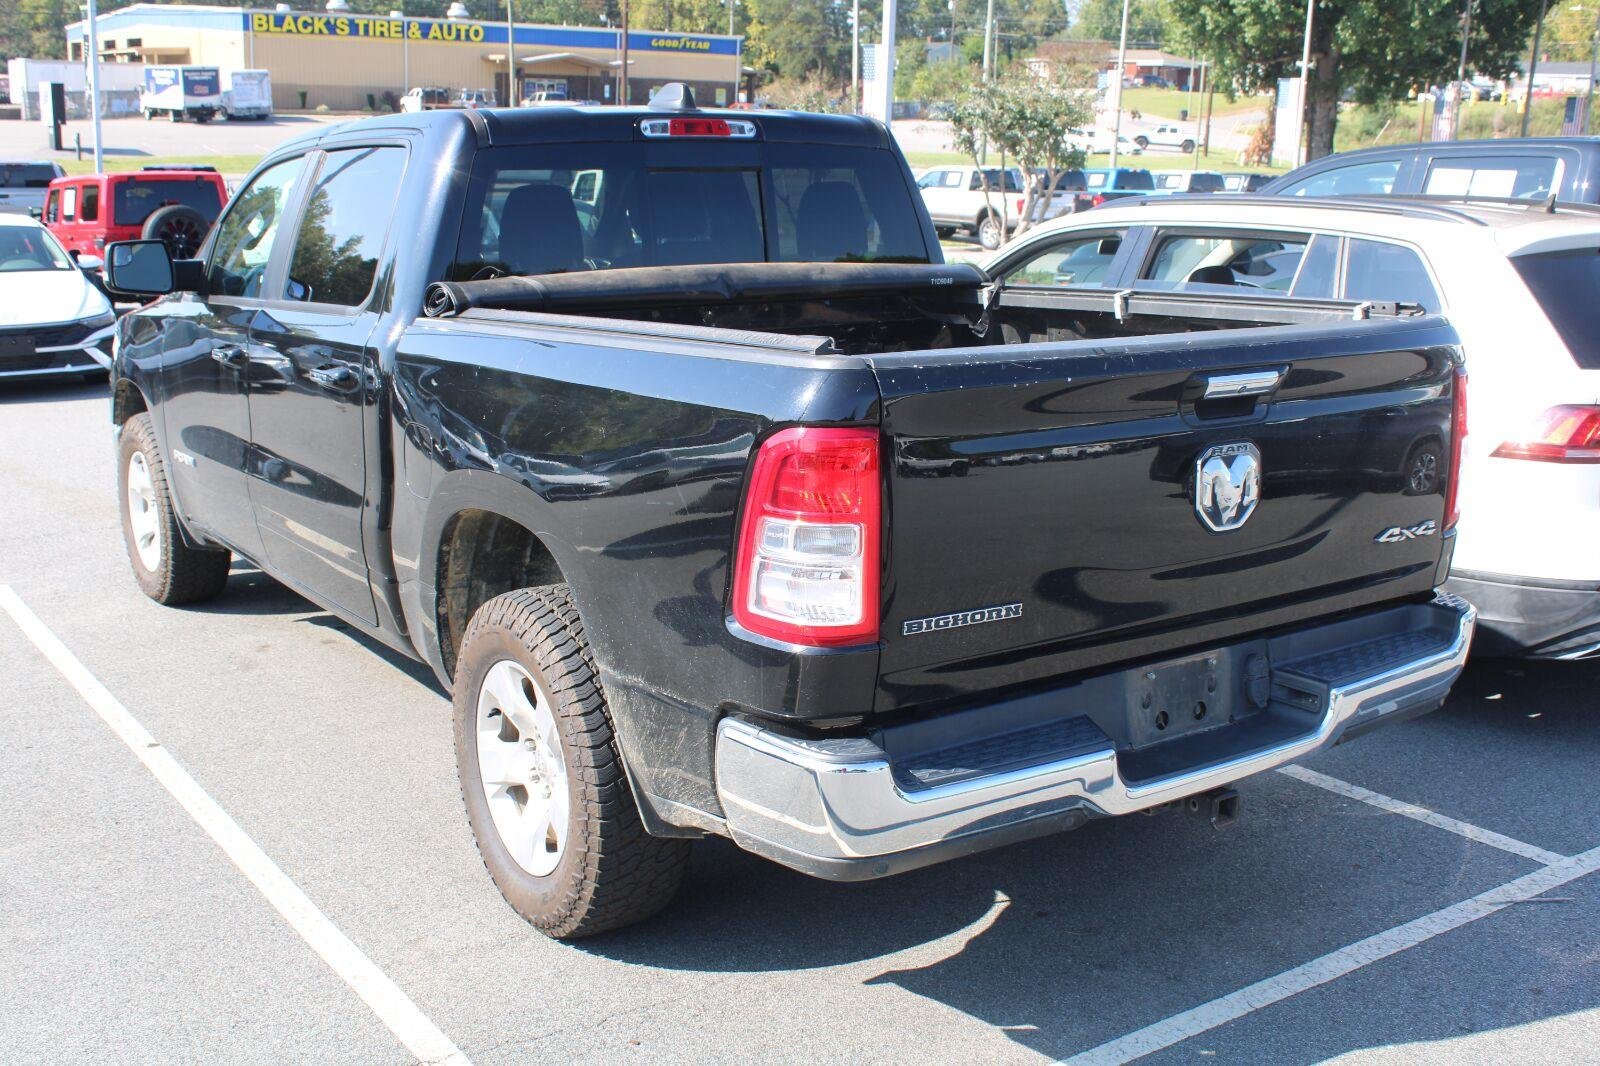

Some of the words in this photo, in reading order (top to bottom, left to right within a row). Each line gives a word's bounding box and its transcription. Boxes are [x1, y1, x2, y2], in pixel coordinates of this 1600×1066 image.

[253, 14, 350, 35] BLACK'S
[354, 18, 404, 38] TIRE
[408, 21, 422, 39] &
[428, 23, 485, 42] AUTO
[651, 38, 710, 50] GOODYEAR
[1210, 444, 1249, 457] RAM
[903, 603, 1023, 635] BIGHORN
